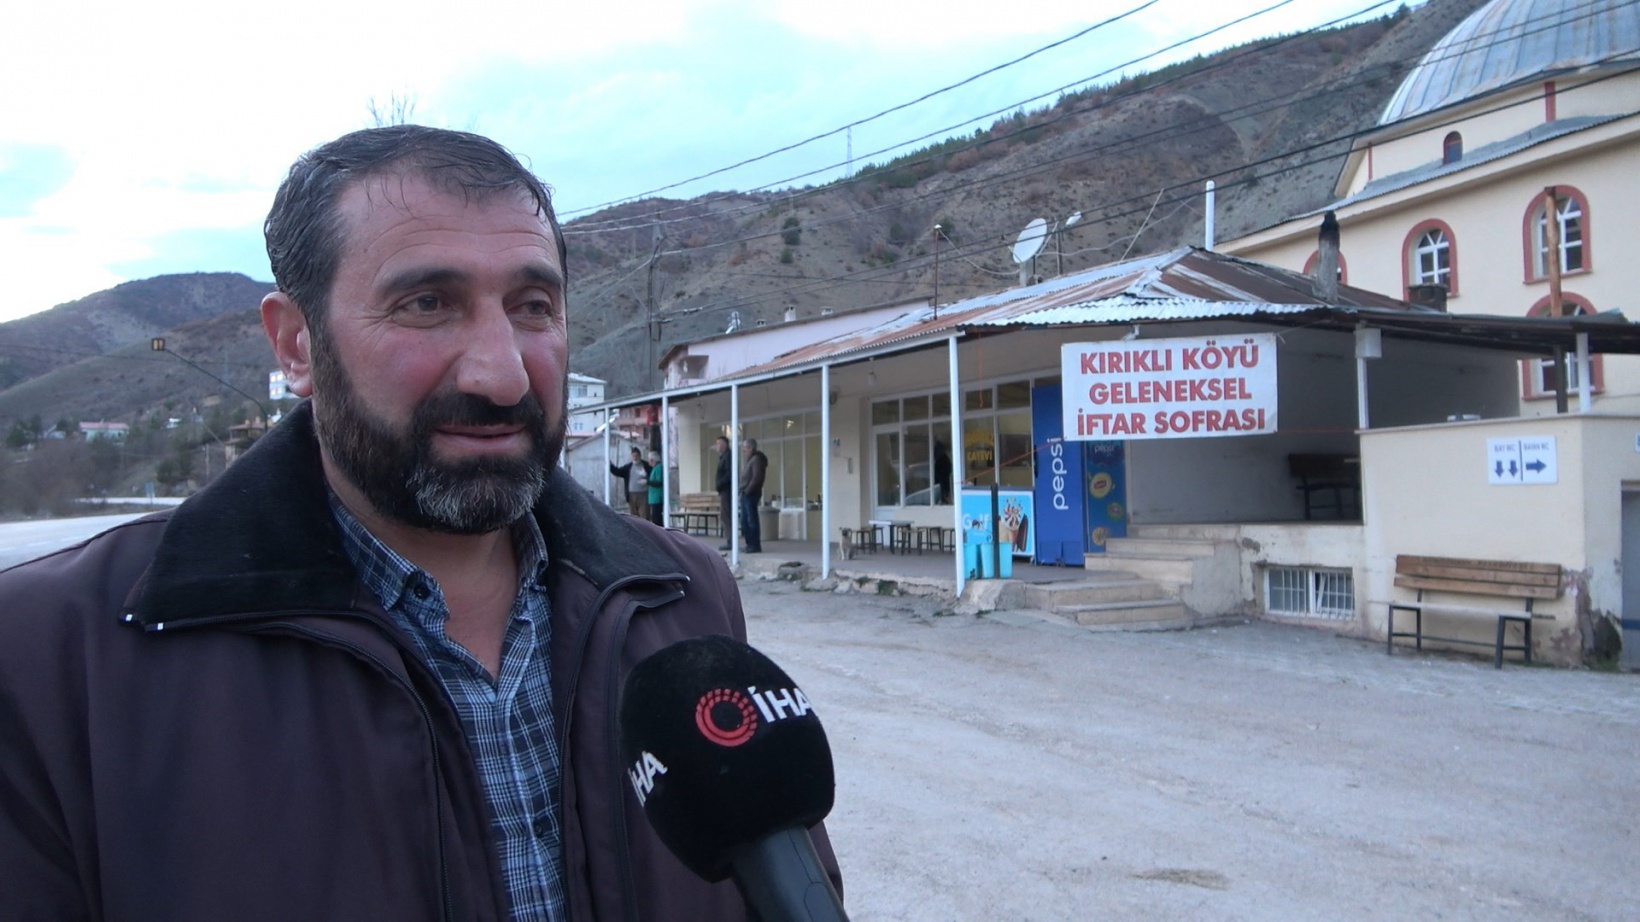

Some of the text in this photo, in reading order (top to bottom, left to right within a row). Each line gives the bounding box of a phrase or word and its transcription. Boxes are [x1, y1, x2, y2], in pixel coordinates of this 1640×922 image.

[1081, 338, 1259, 375] KIRIKLI KÖYÜ
[1089, 377, 1252, 405] GELENEKSEL
[1077, 408, 1265, 436] İFTAR SOFRASI
[1047, 437, 1069, 511] pepsi
[747, 685, 811, 723] İHA
